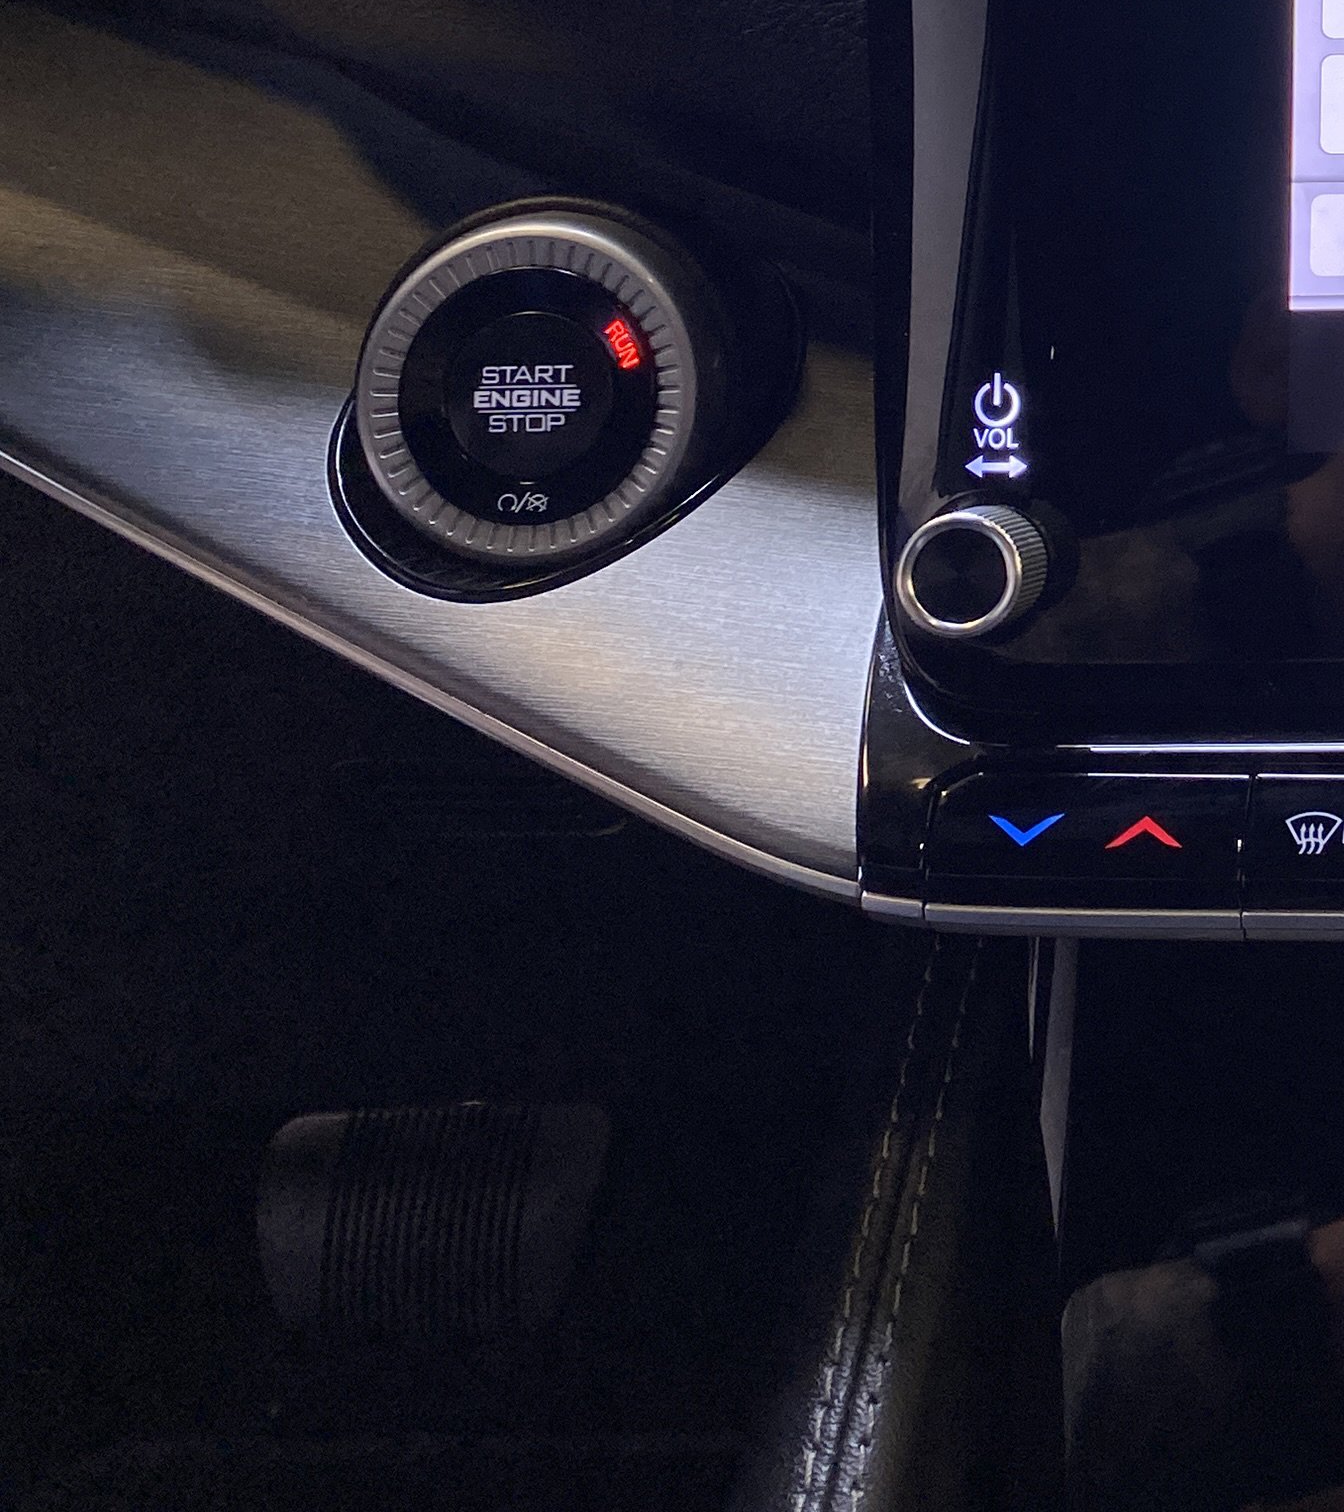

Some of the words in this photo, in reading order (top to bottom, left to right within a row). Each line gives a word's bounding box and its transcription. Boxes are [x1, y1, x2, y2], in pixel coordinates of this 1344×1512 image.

[603, 318, 641, 369] RUN
[481, 364, 574, 384] START
[473, 389, 581, 407] ENGINE
[488, 413, 566, 433] STOP
[973, 427, 1020, 450] VOL
